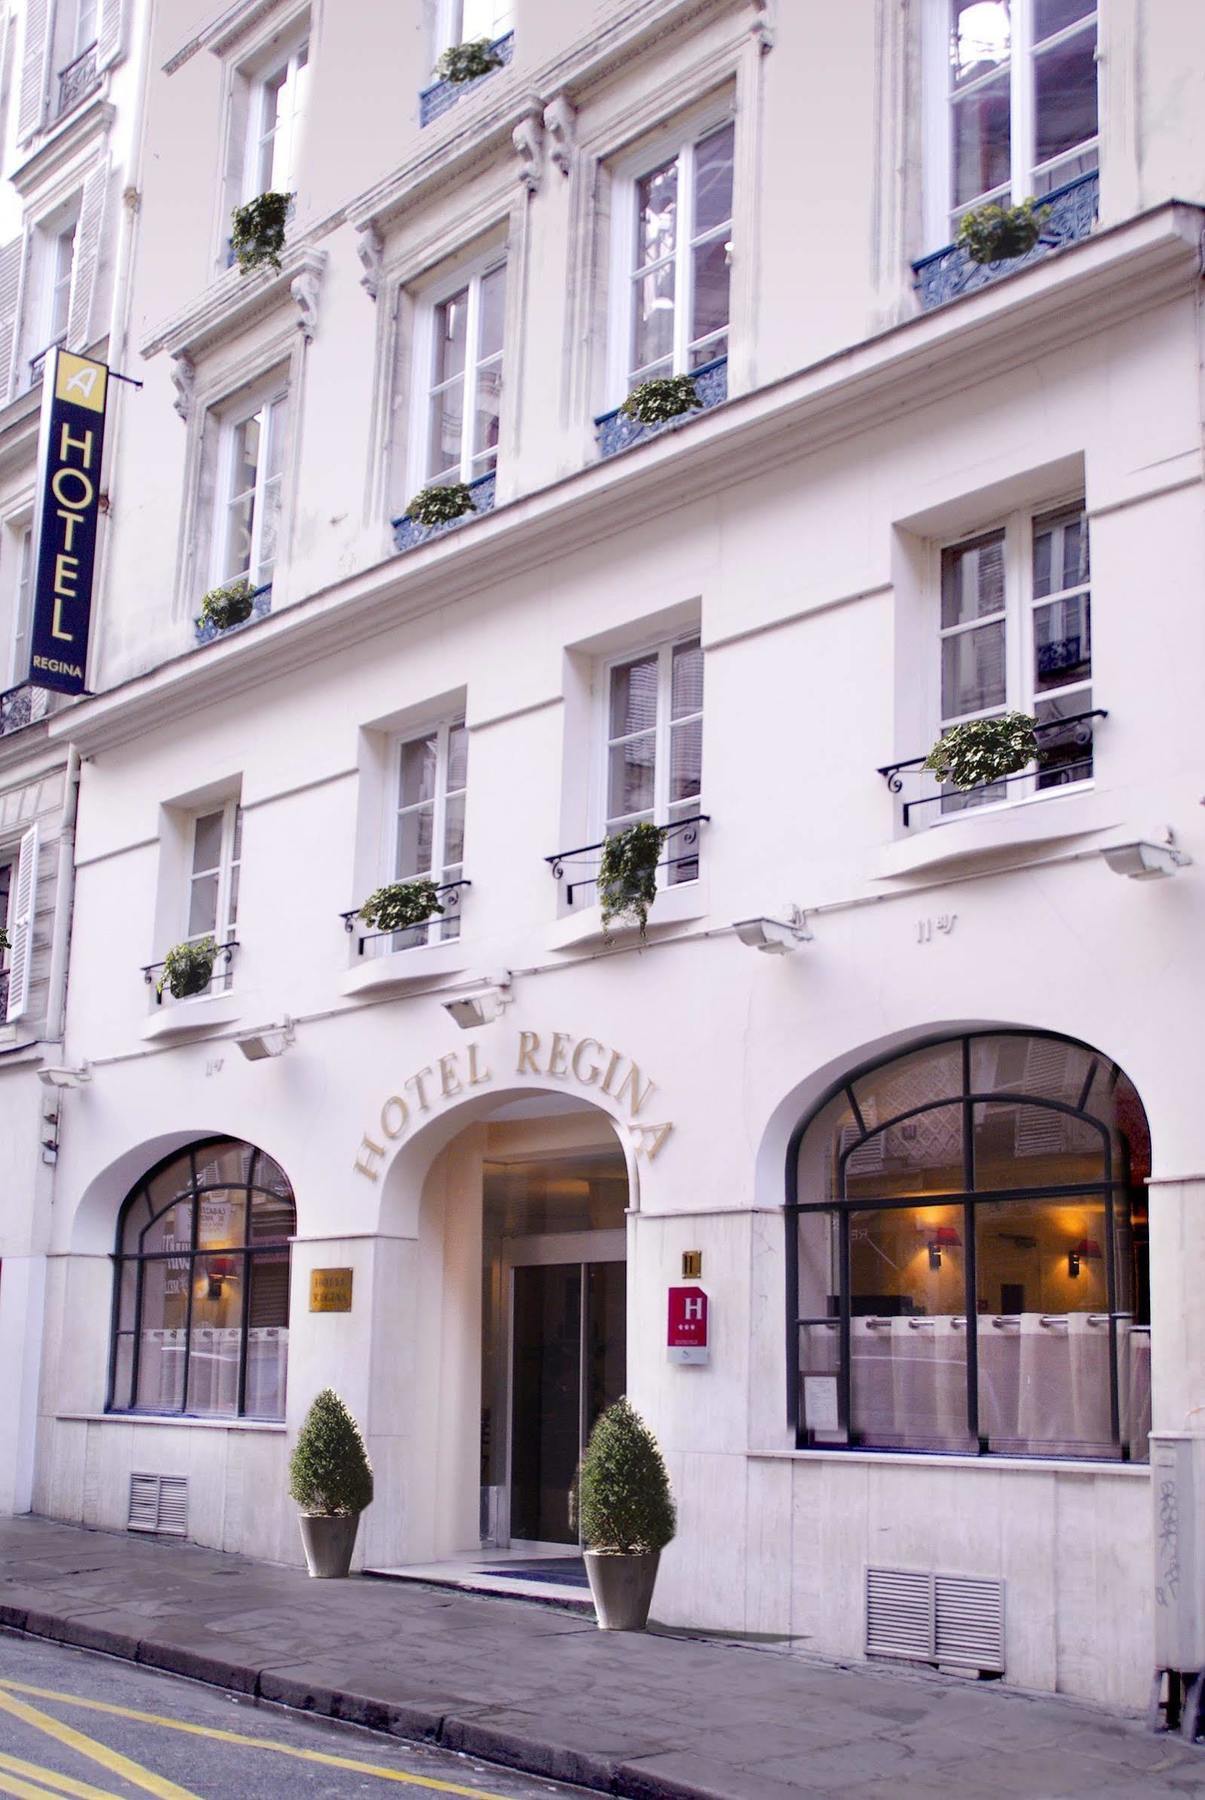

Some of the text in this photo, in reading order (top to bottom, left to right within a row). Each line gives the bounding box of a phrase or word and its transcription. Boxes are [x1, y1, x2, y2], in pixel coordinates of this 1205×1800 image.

[52, 423, 93, 641] HOTEL
[33, 655, 83, 679] REGINA
[353, 1030, 675, 1184] HOTEL REGINA
[684, 1297, 702, 1320] H
